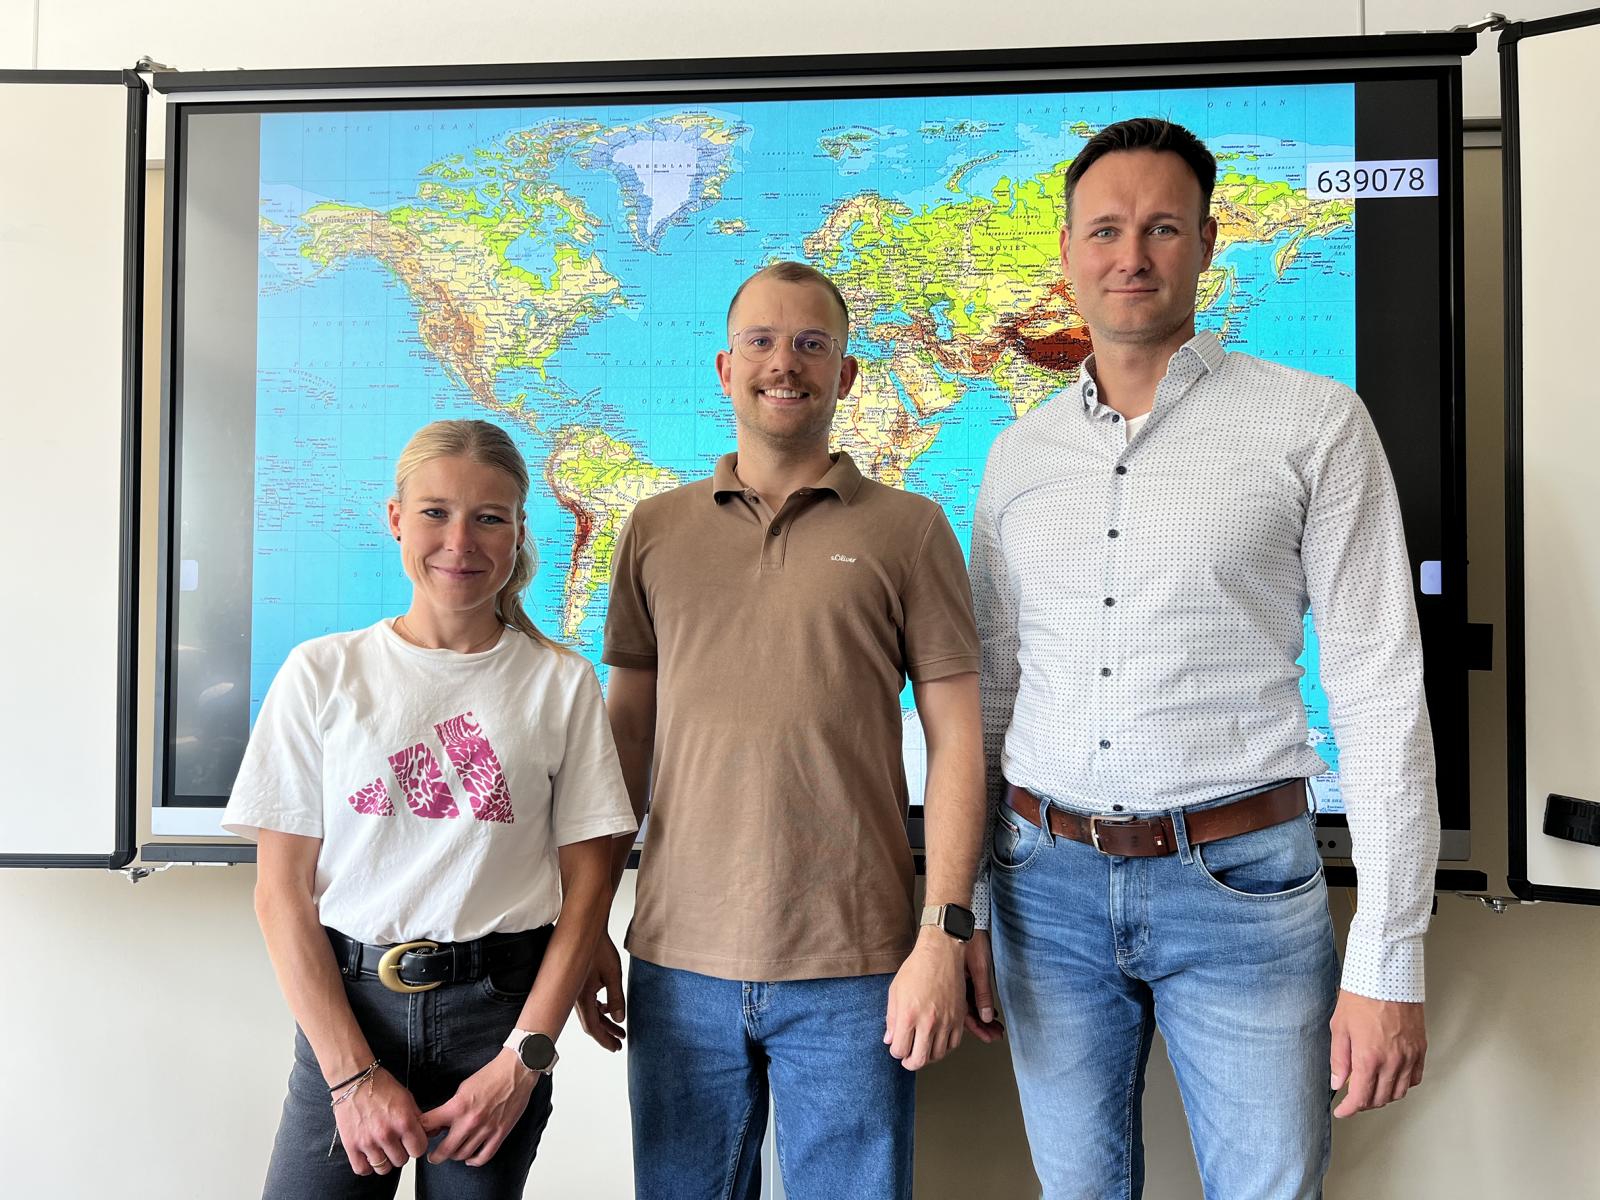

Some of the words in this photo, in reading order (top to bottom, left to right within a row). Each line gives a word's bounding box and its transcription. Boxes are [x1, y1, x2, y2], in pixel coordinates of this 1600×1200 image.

[1026, 105, 1118, 114] ARCTIC
[1207, 99, 1286, 108] OCEAN
[414, 122, 474, 131] OCEAN
[1318, 167, 1425, 193] 639078
[1274, 314, 1333, 322] NORTH
[1259, 349, 1346, 357] PACIFIC
